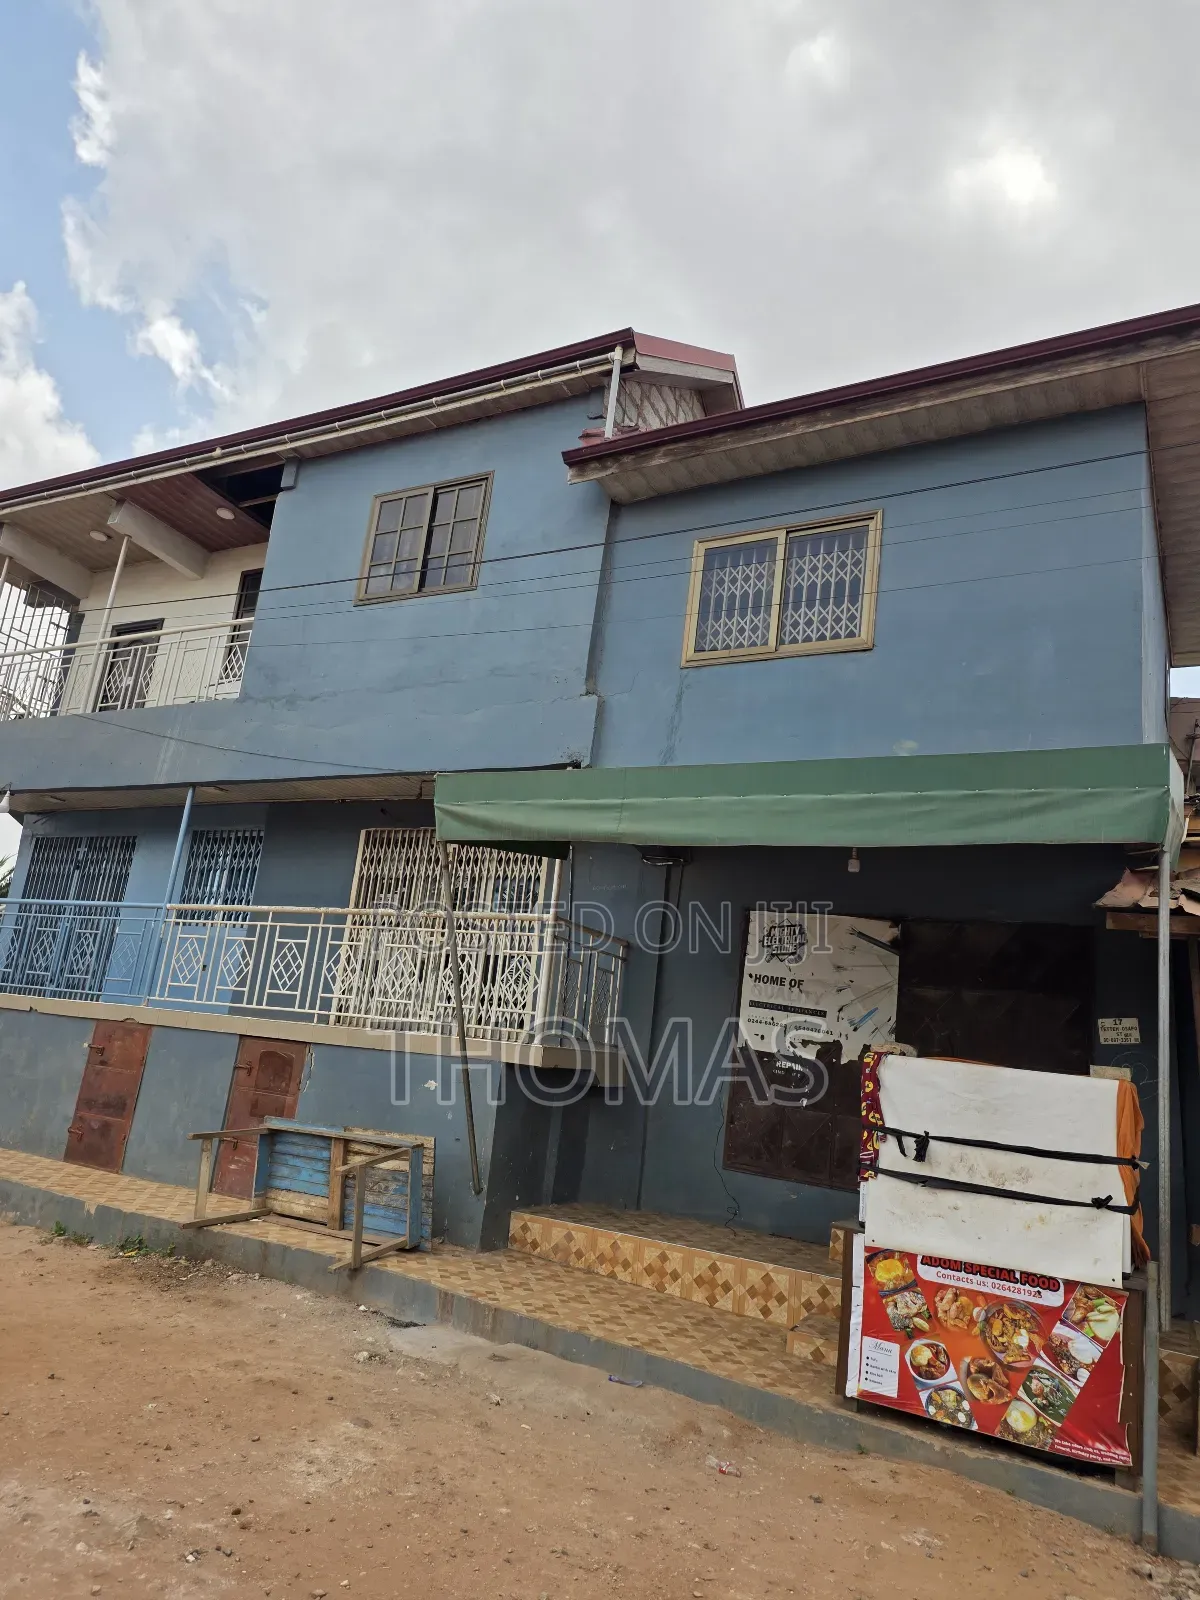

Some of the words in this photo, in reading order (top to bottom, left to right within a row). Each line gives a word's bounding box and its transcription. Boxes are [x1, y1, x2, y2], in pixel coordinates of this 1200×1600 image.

[770, 926, 800, 936] MIGHTY
[764, 934, 806, 945] ELECTRICAL
[754, 973, 787, 986] HOME
[789, 978, 805, 988] OF
[921, 1255, 963, 1272] ADOM
[964, 1262, 1018, 1284] SPECIAL
[1020, 1270, 1060, 1292] FOOD
[936, 1271, 974, 1284] Contacts
